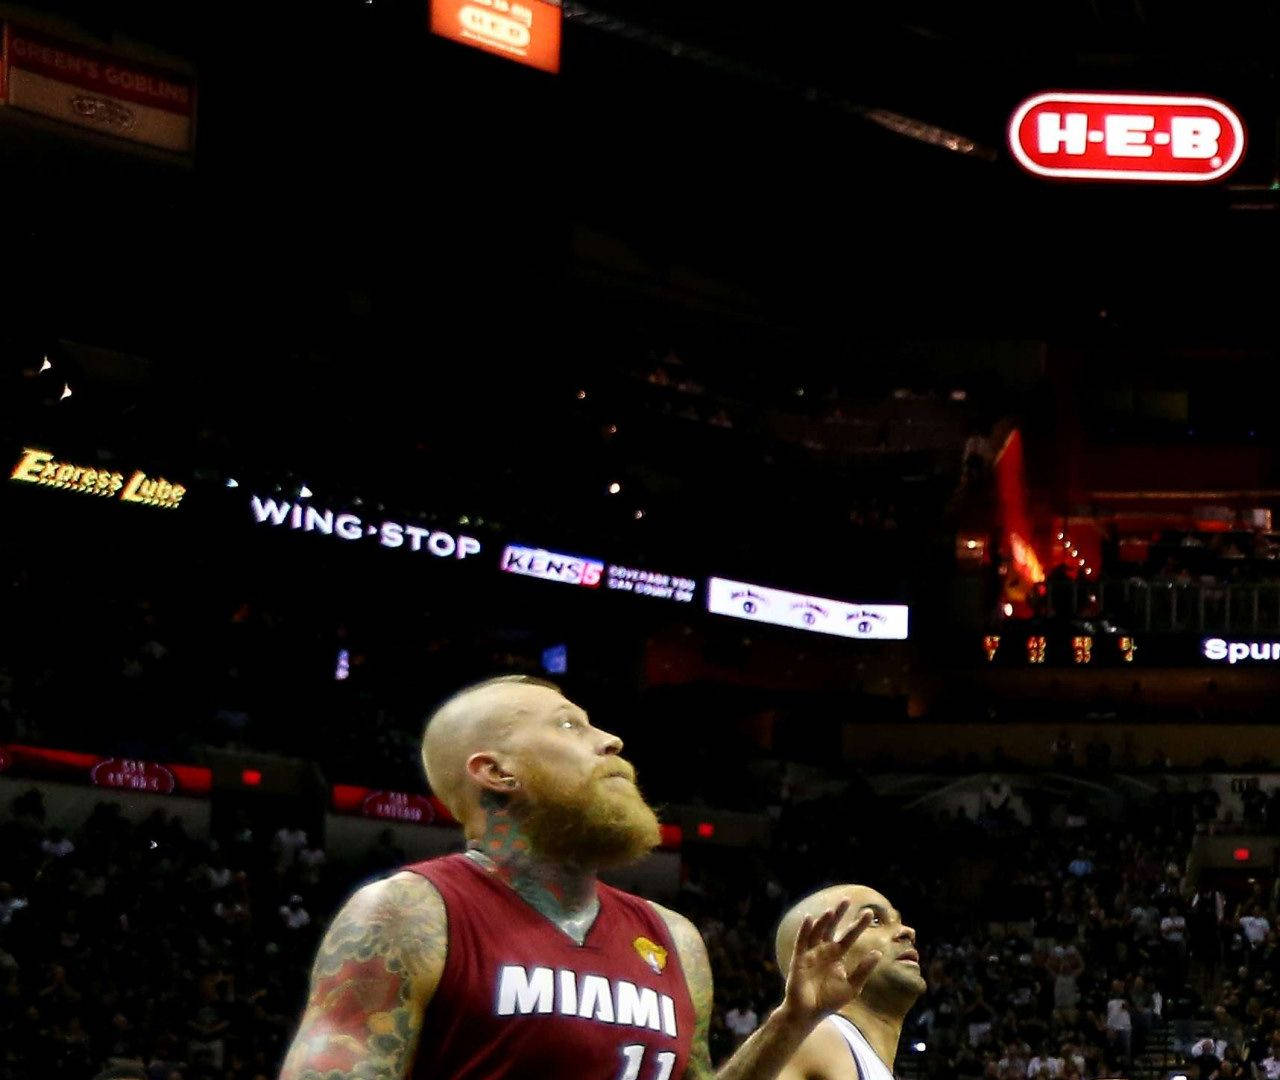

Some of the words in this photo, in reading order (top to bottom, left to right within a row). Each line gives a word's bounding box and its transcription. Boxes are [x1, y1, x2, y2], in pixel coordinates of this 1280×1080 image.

[1037, 111, 1222, 160] H-E-B
[9, 446, 124, 497] Express
[120, 469, 187, 508] Lube
[498, 965, 677, 1039] MIAMI
